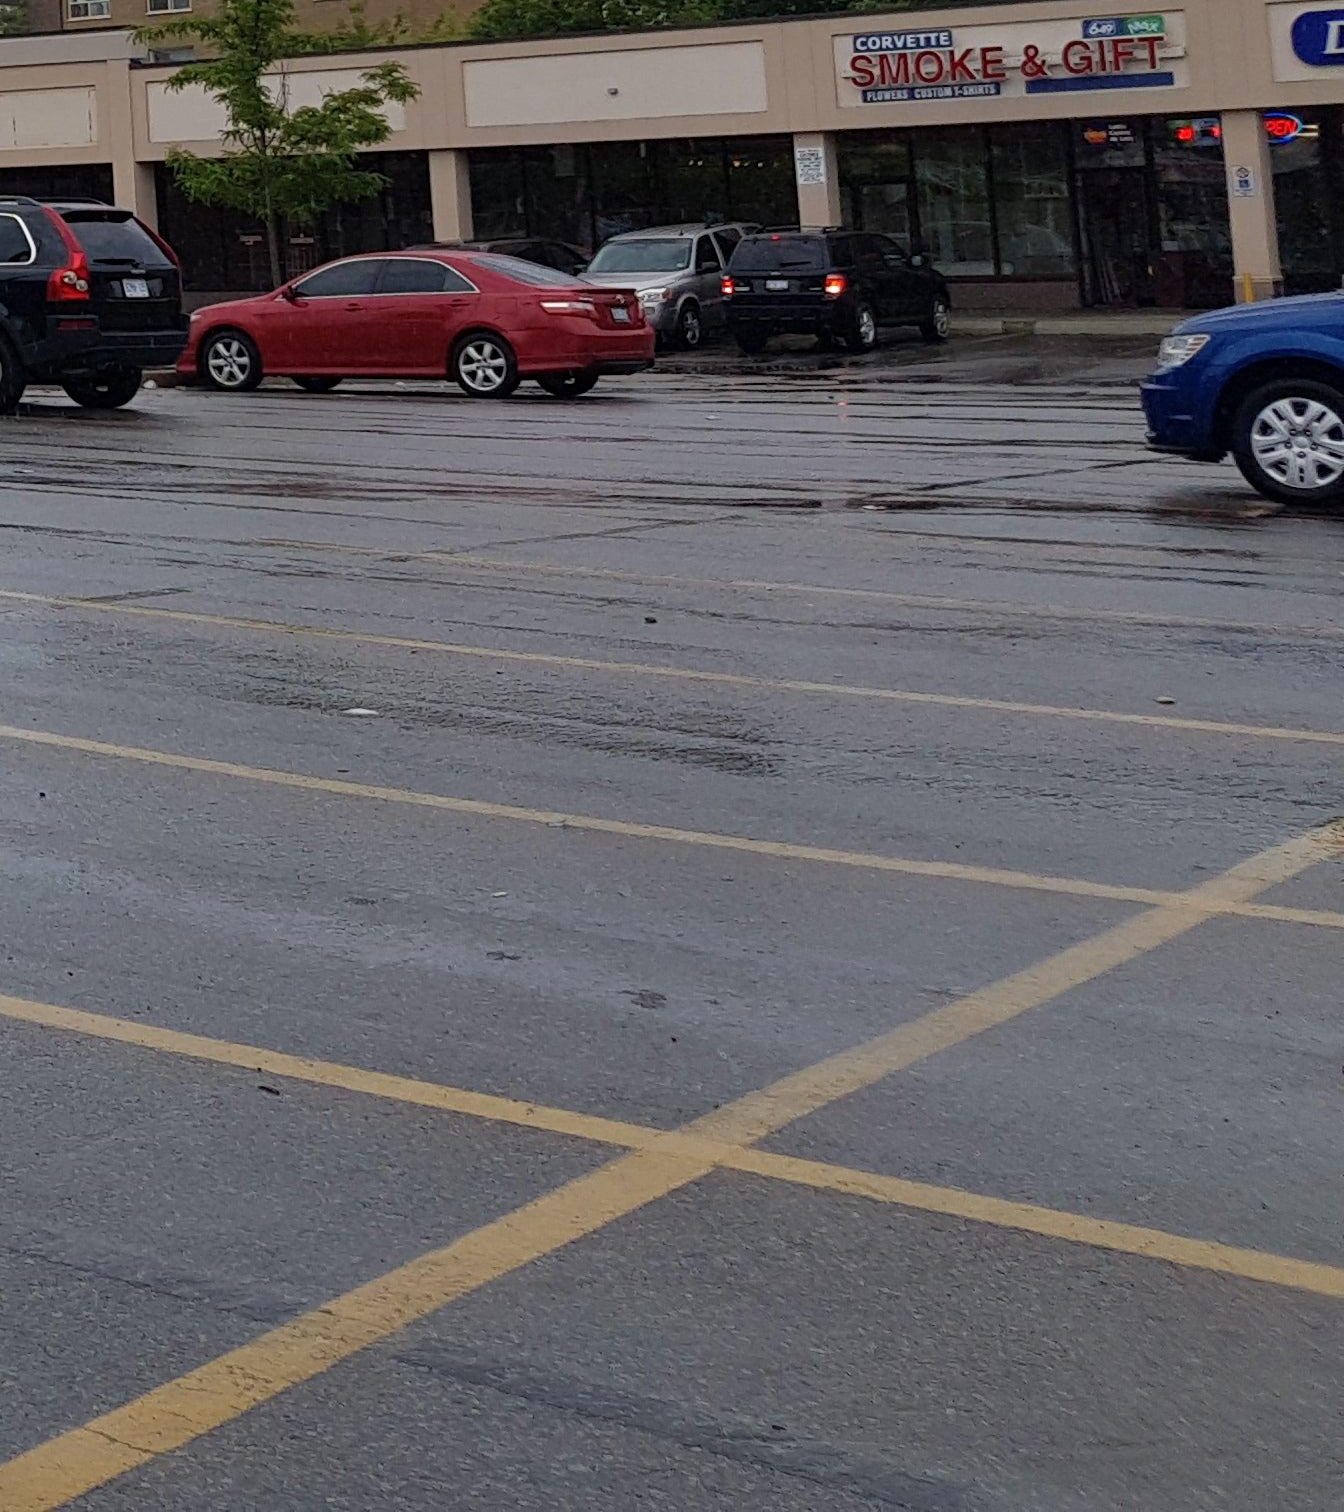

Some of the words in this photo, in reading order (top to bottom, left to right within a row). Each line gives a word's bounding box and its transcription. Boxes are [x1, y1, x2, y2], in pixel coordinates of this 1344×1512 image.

[854, 31, 950, 51] CORVETTE
[849, 46, 1007, 88] SMOKE
[1019, 43, 1049, 78] &
[1062, 35, 1165, 75] GIFT
[866, 90, 908, 102] FLOWERS
[913, 87, 952, 99] CUSTOM
[954, 84, 996, 96] T-SHIRTS
[1264, 118, 1297, 137] PEN
